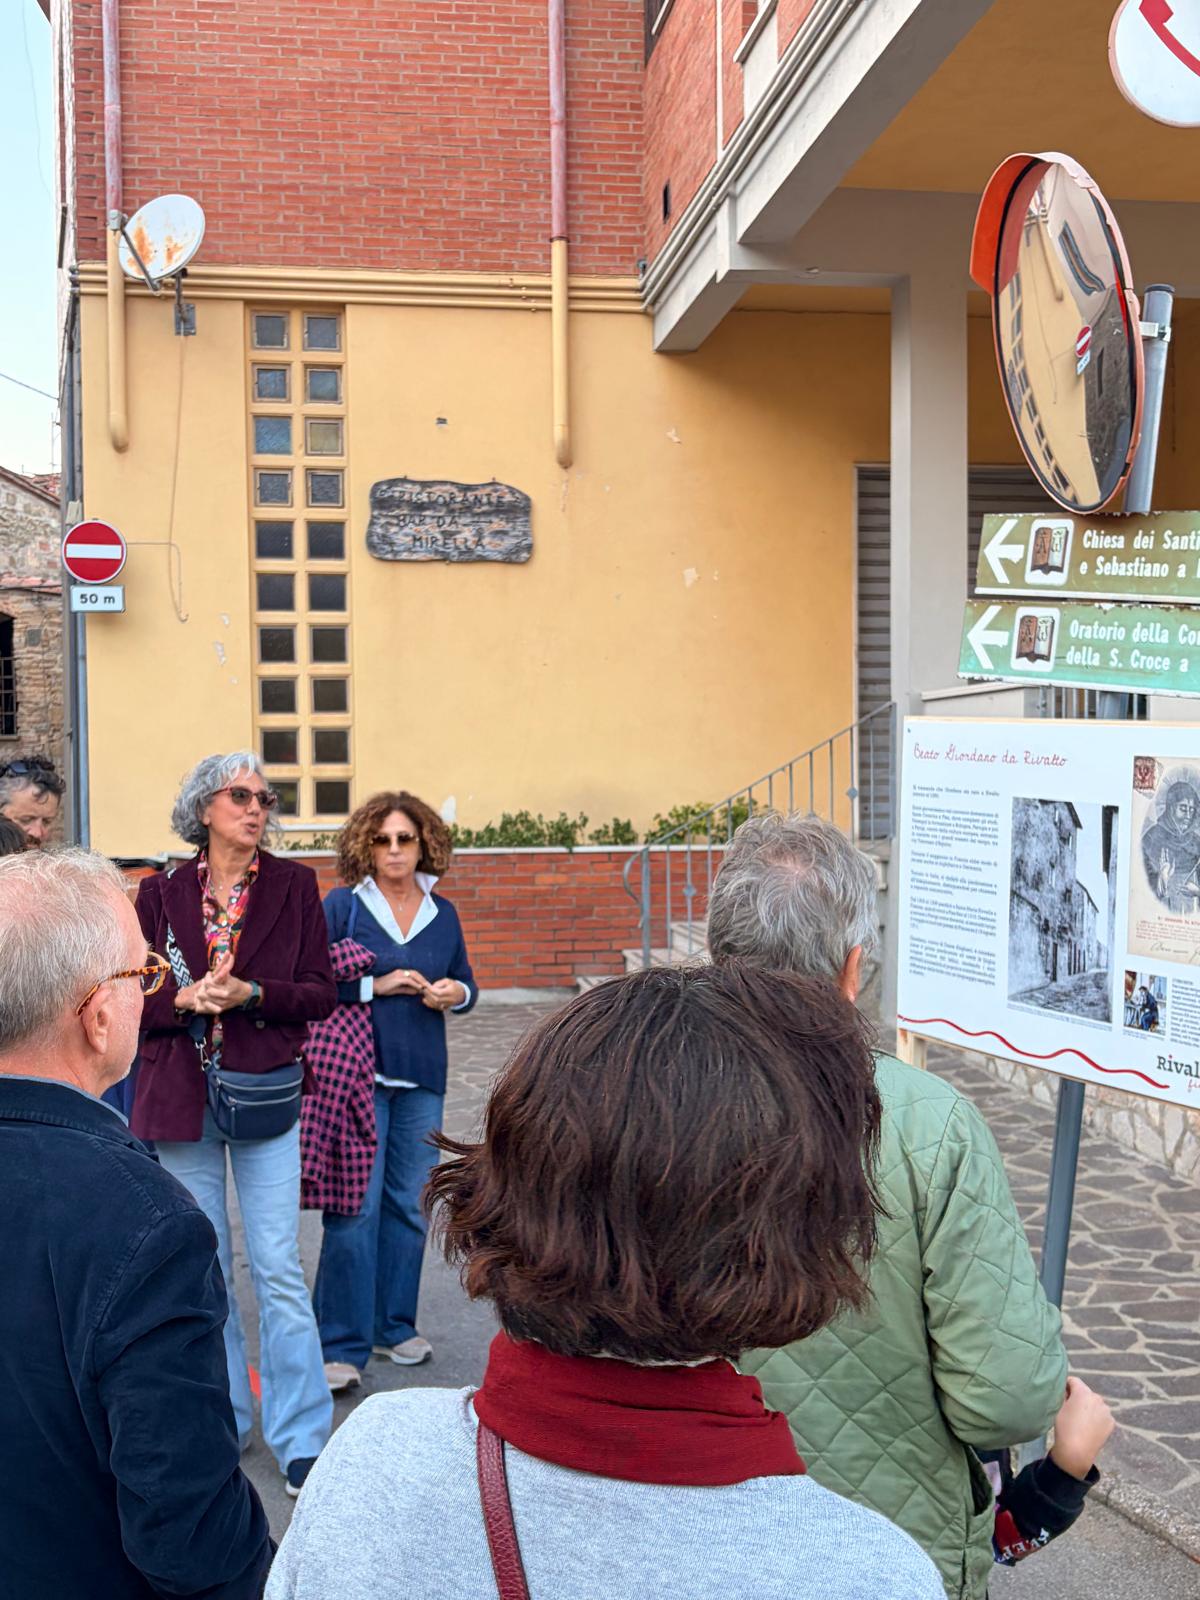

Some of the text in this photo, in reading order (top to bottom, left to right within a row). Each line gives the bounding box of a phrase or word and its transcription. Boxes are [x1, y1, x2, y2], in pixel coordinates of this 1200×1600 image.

[399, 490, 506, 508] RISTORANTE
[437, 514, 459, 528] DA
[411, 535, 486, 551] MIRELLA
[1083, 529, 1125, 549] Chiesa
[1133, 529, 1155, 550] dei
[1080, 562, 1087, 575] e
[1096, 555, 1170, 578] Sebastiano
[1177, 564, 1187, 578] a
[80, 594, 115, 605] 50 m
[1070, 618, 1125, 642] Oratorio
[1132, 621, 1168, 644] della
[1066, 646, 1189, 673] della S. Croce a
[913, 742, 940, 761] Beato
[945, 743, 998, 764] Giordano
[1002, 748, 1018, 764] da
